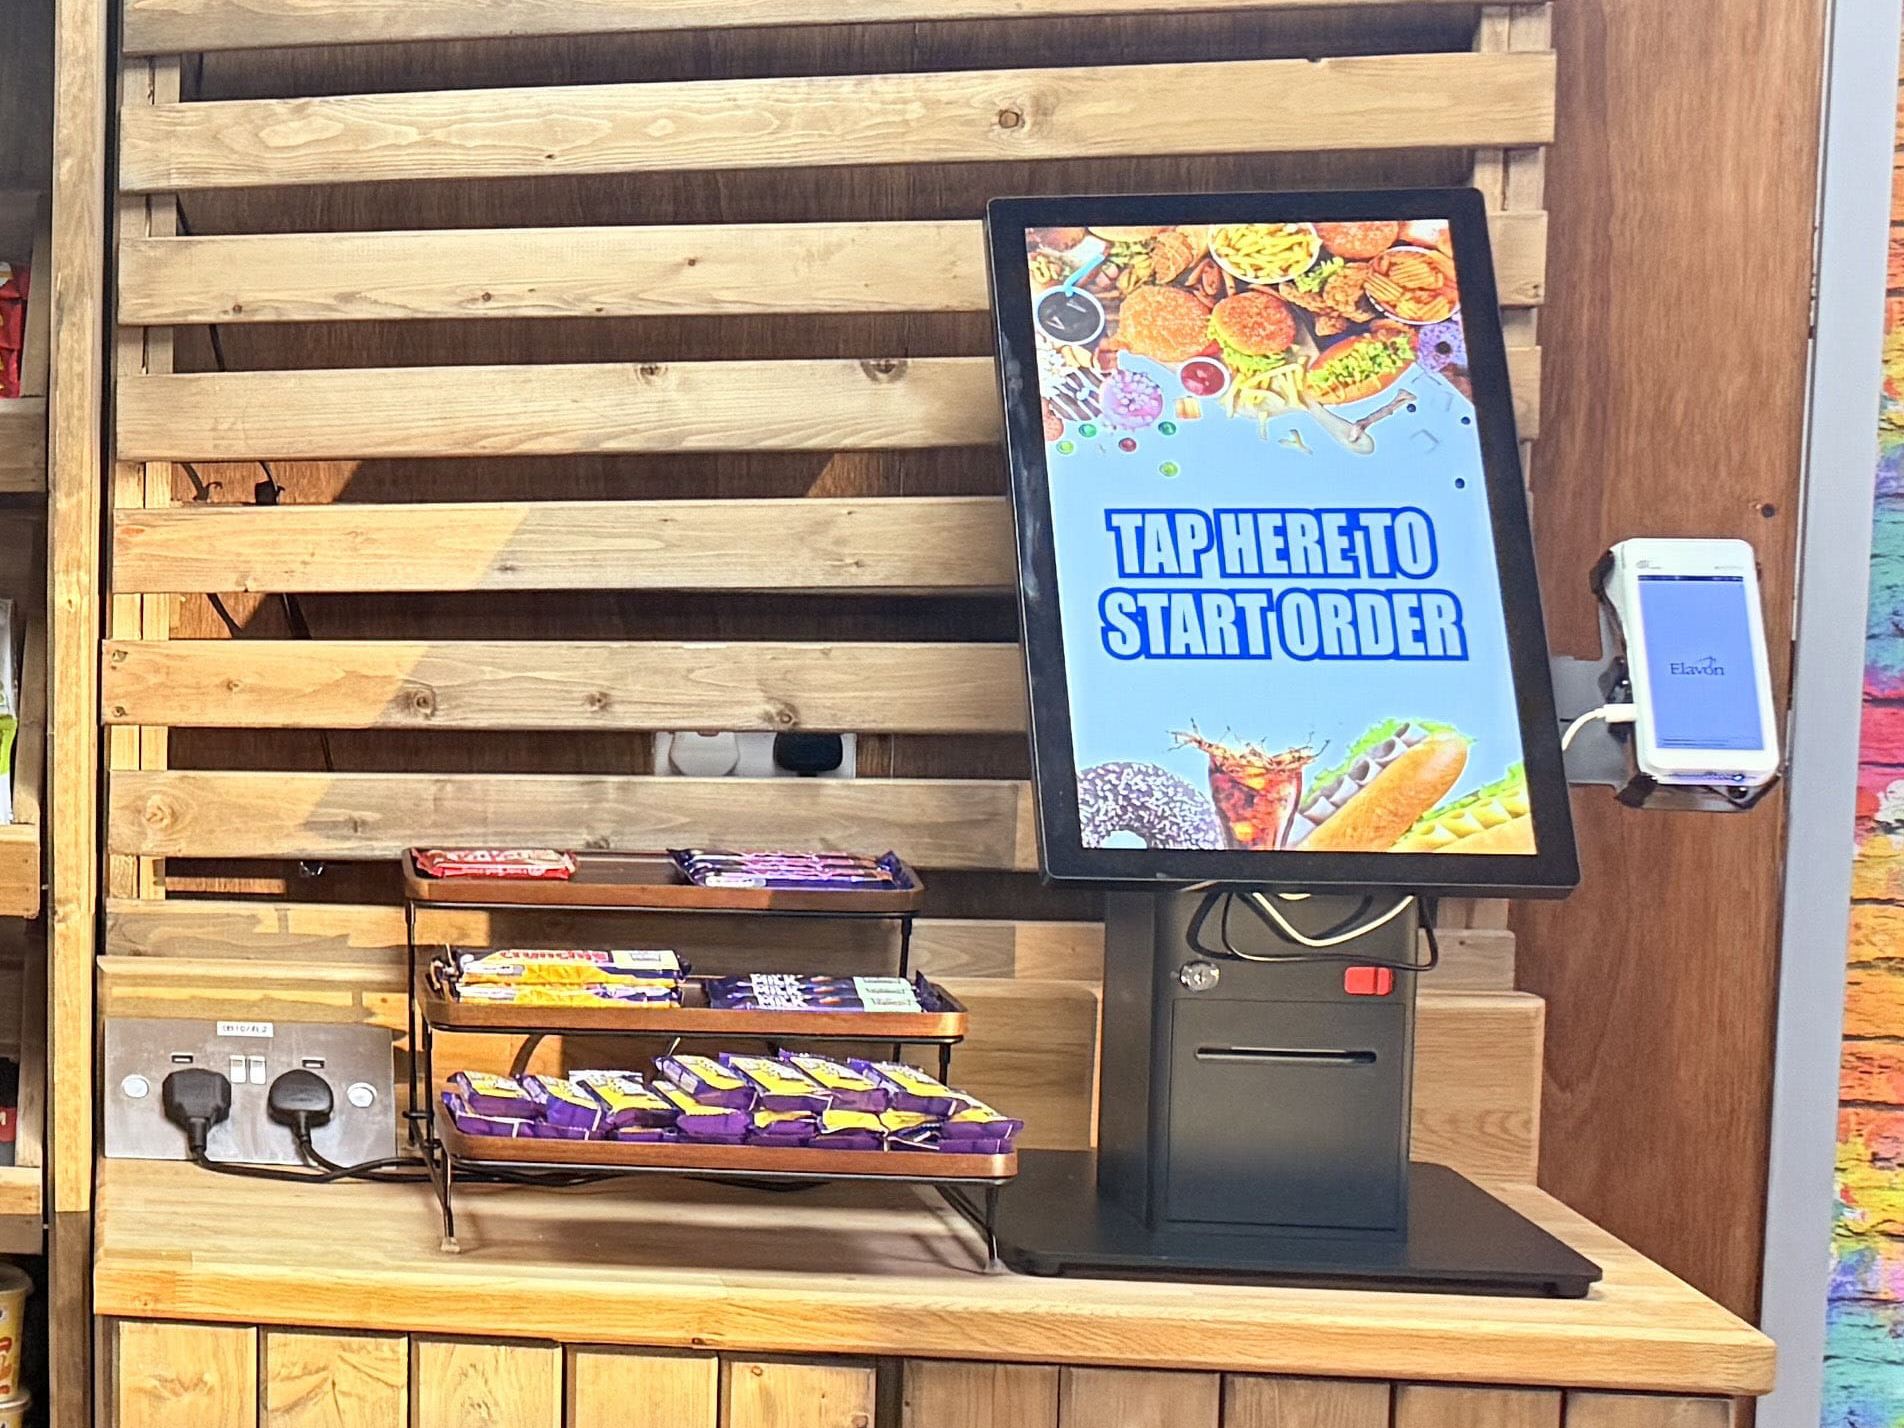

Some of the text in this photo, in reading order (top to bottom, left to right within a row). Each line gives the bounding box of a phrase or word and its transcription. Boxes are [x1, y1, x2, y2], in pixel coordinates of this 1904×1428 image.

[1104, 507, 1439, 580] TAP HERE TO
[1099, 588, 1468, 661] START ORDER
[1669, 660, 1725, 677] Elavon
